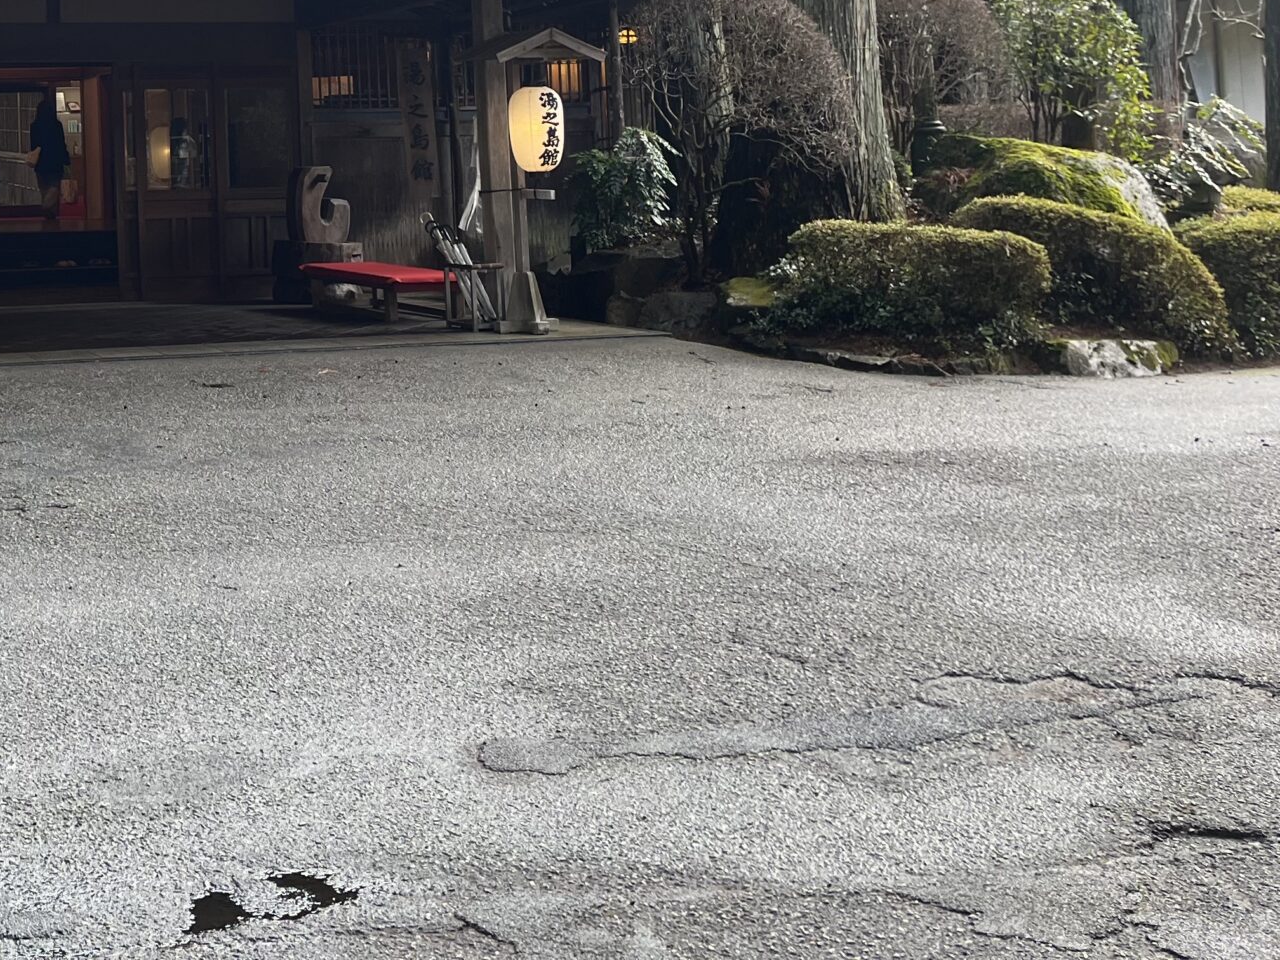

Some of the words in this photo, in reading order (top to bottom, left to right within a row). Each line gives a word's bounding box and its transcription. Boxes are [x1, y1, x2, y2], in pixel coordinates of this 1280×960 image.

[403, 62, 433, 180] 湯之島館
[539, 92, 559, 166] 湯之島館
